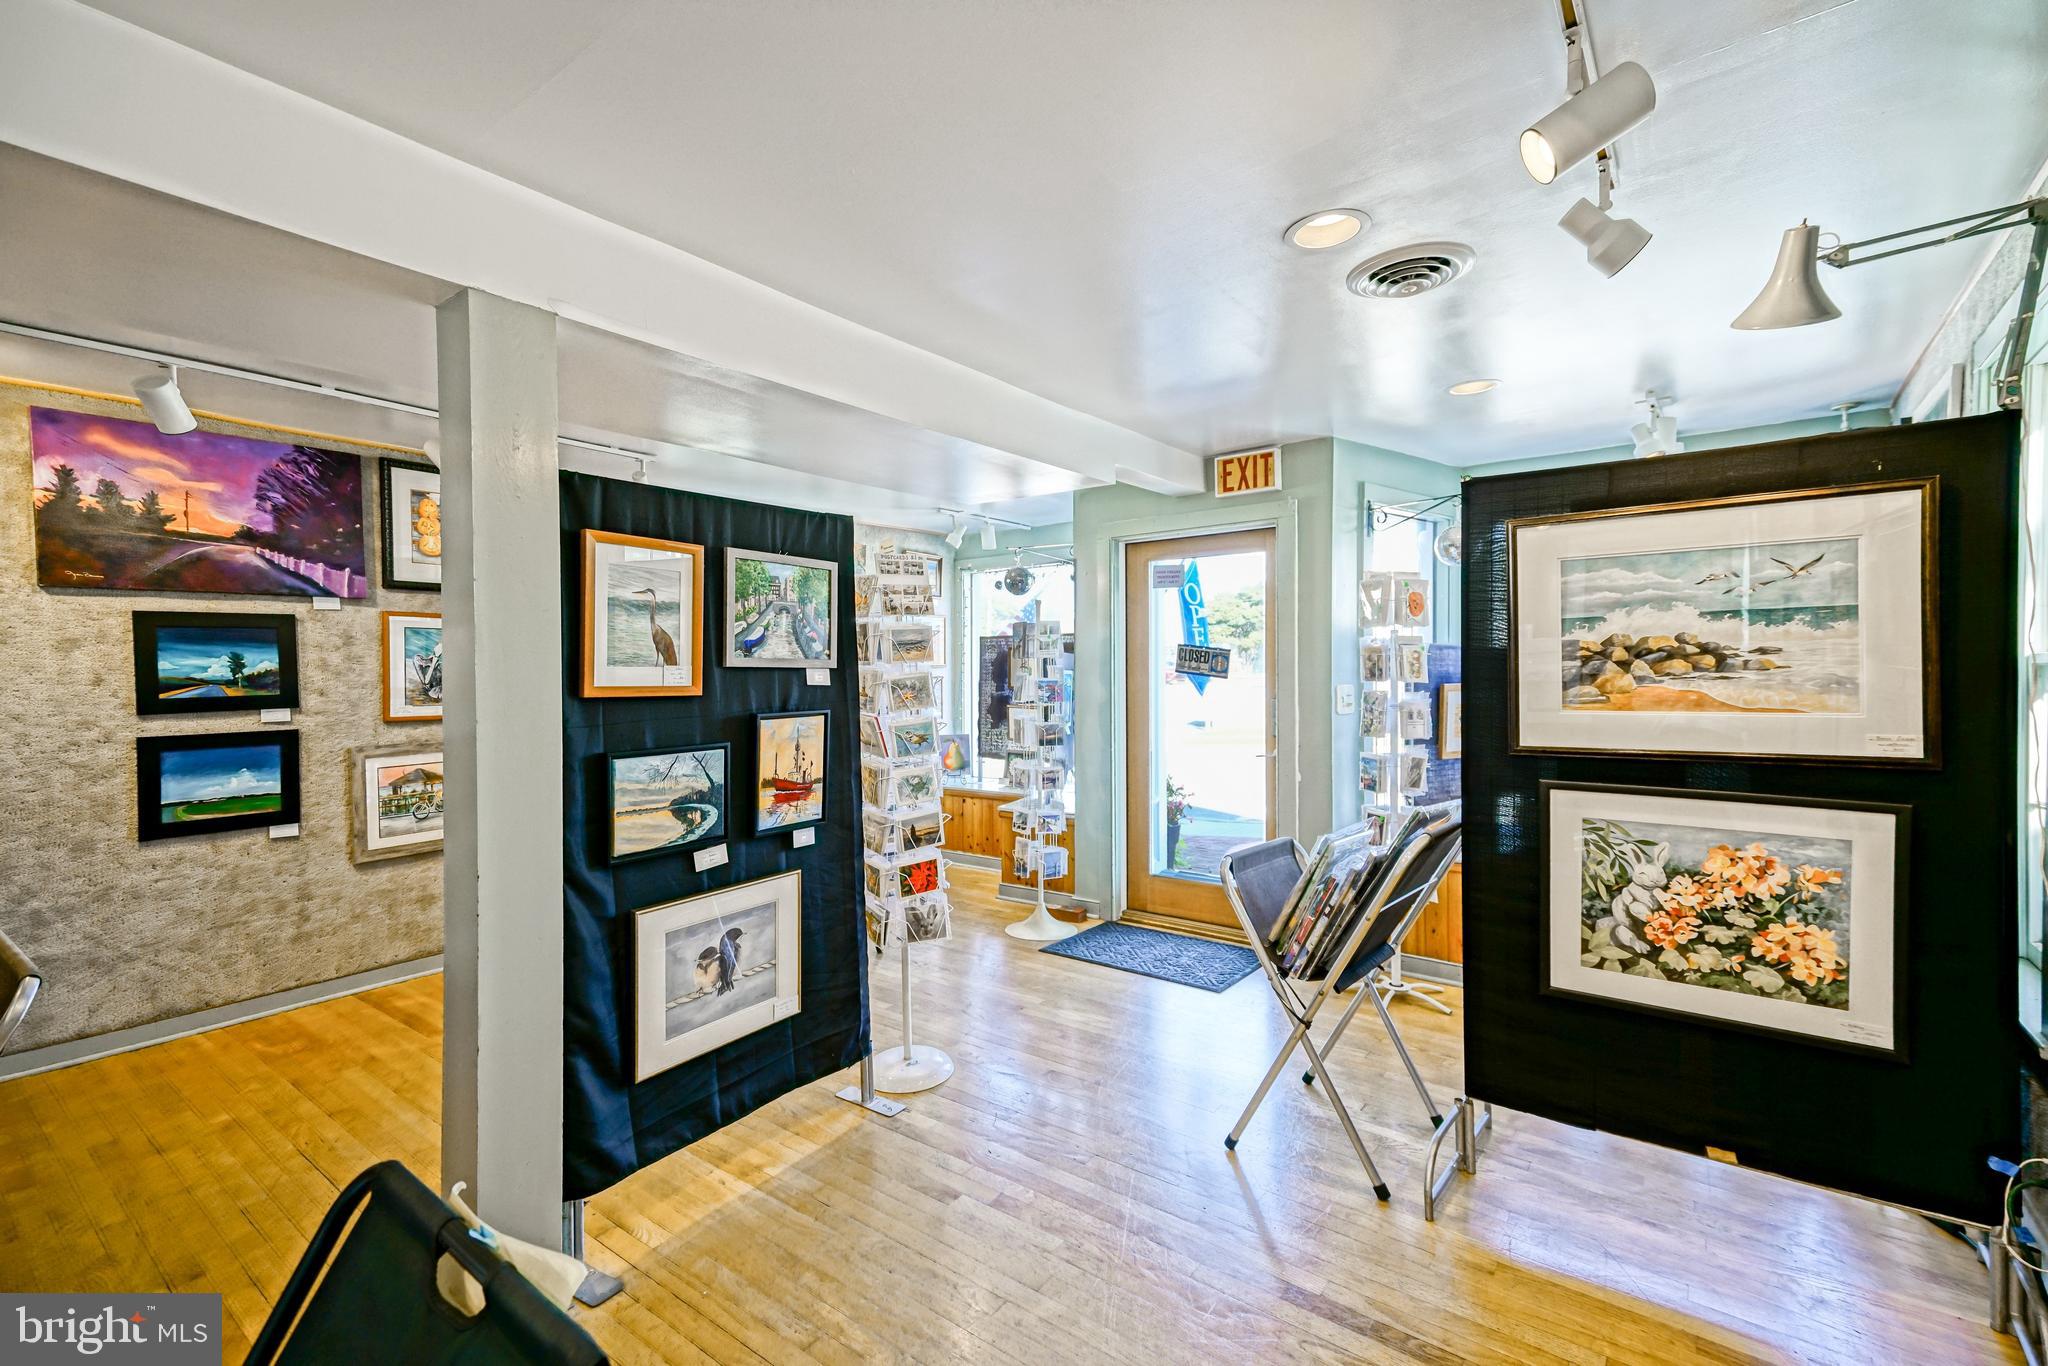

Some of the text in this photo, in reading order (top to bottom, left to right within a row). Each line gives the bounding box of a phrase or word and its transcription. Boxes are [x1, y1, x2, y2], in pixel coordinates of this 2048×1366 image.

[1222, 452, 1273, 493] EXIT
[1184, 582, 1208, 647] OPE
[1178, 647, 1210, 664] CLOSED
